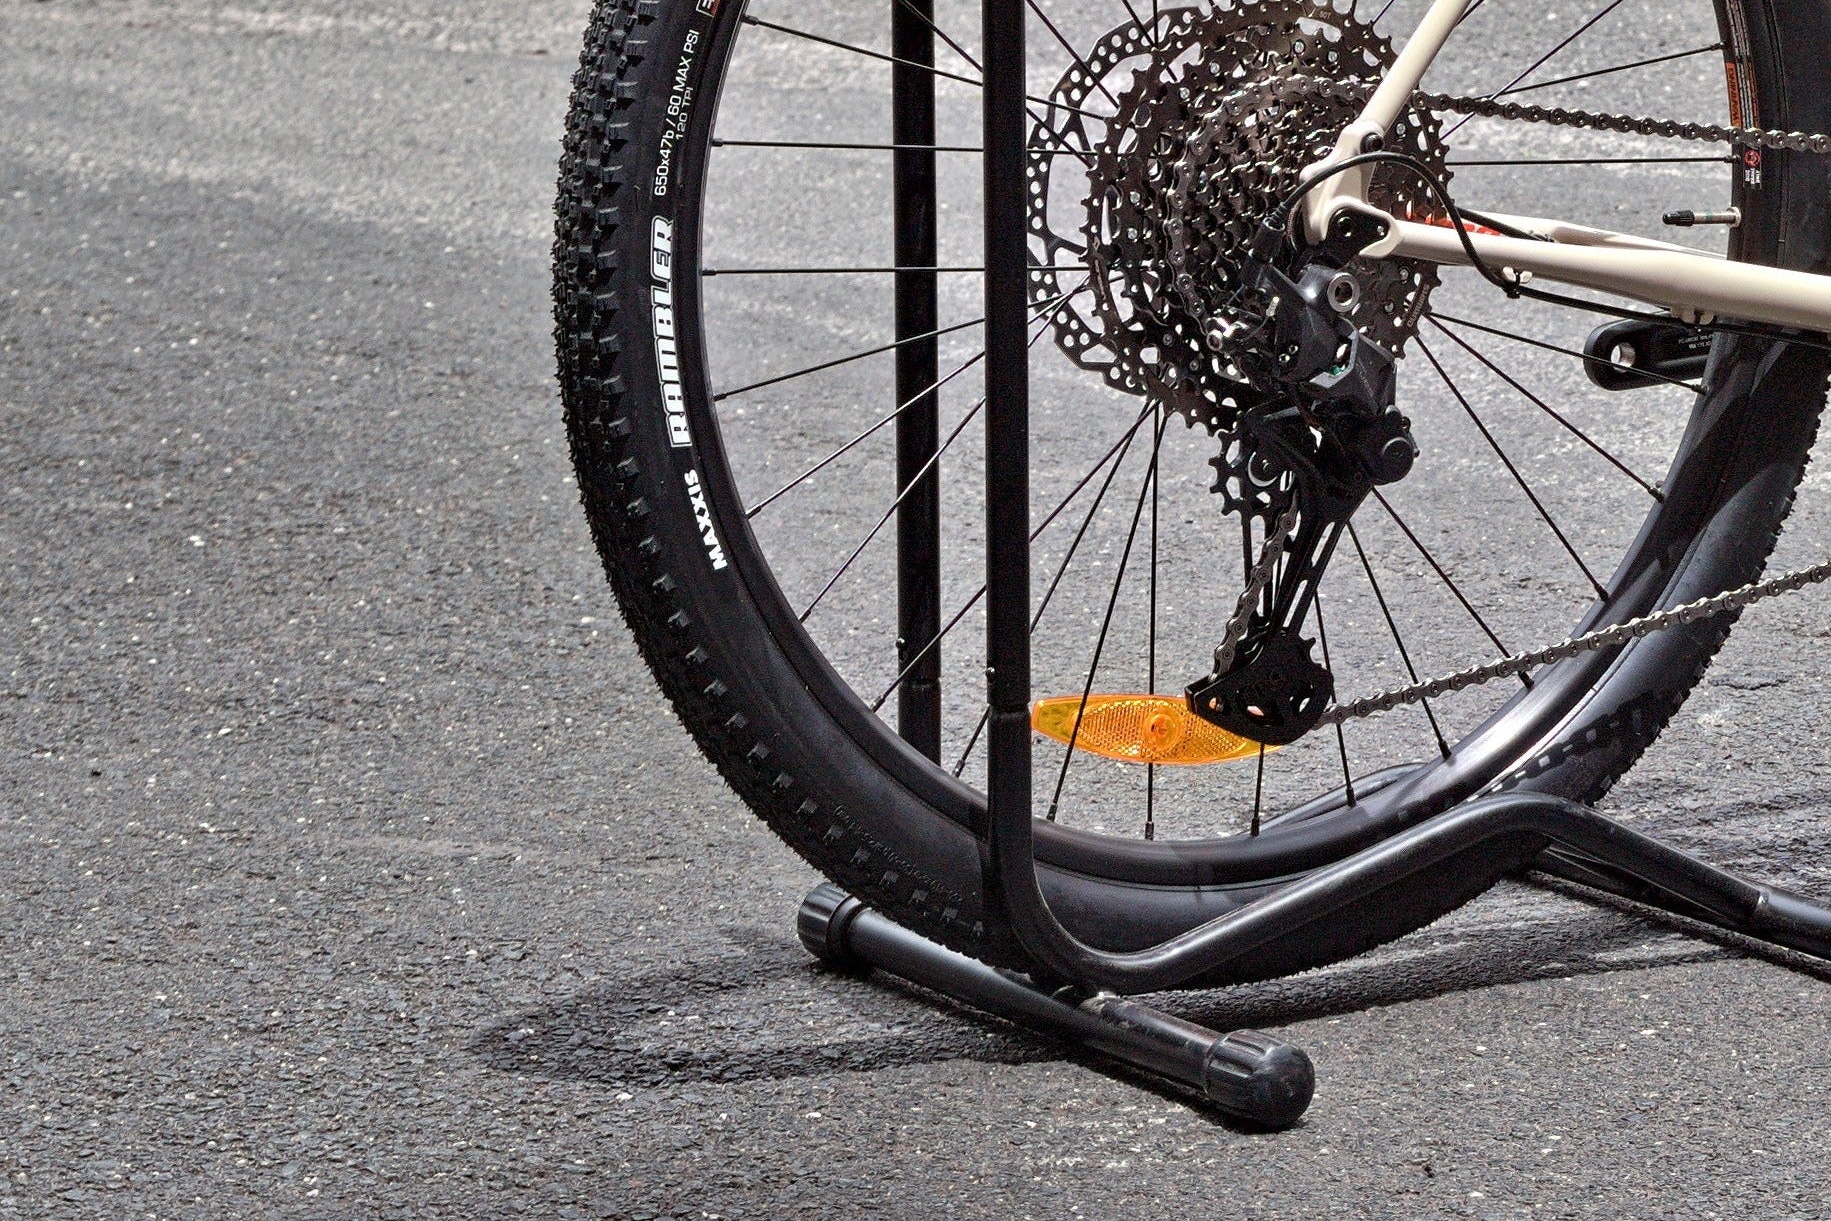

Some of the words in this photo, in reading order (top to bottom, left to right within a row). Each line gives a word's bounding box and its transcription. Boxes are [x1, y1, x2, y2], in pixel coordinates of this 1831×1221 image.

[683, 29, 701, 54] PSI
[672, 55, 693, 92] MAX
[667, 95, 682, 116] 60
[681, 87, 694, 108] TPI
[675, 112, 688, 140] 120
[654, 130, 676, 197] 650x47b
[651, 214, 693, 448] RAMBLER
[684, 469, 728, 571] MAXXIS
